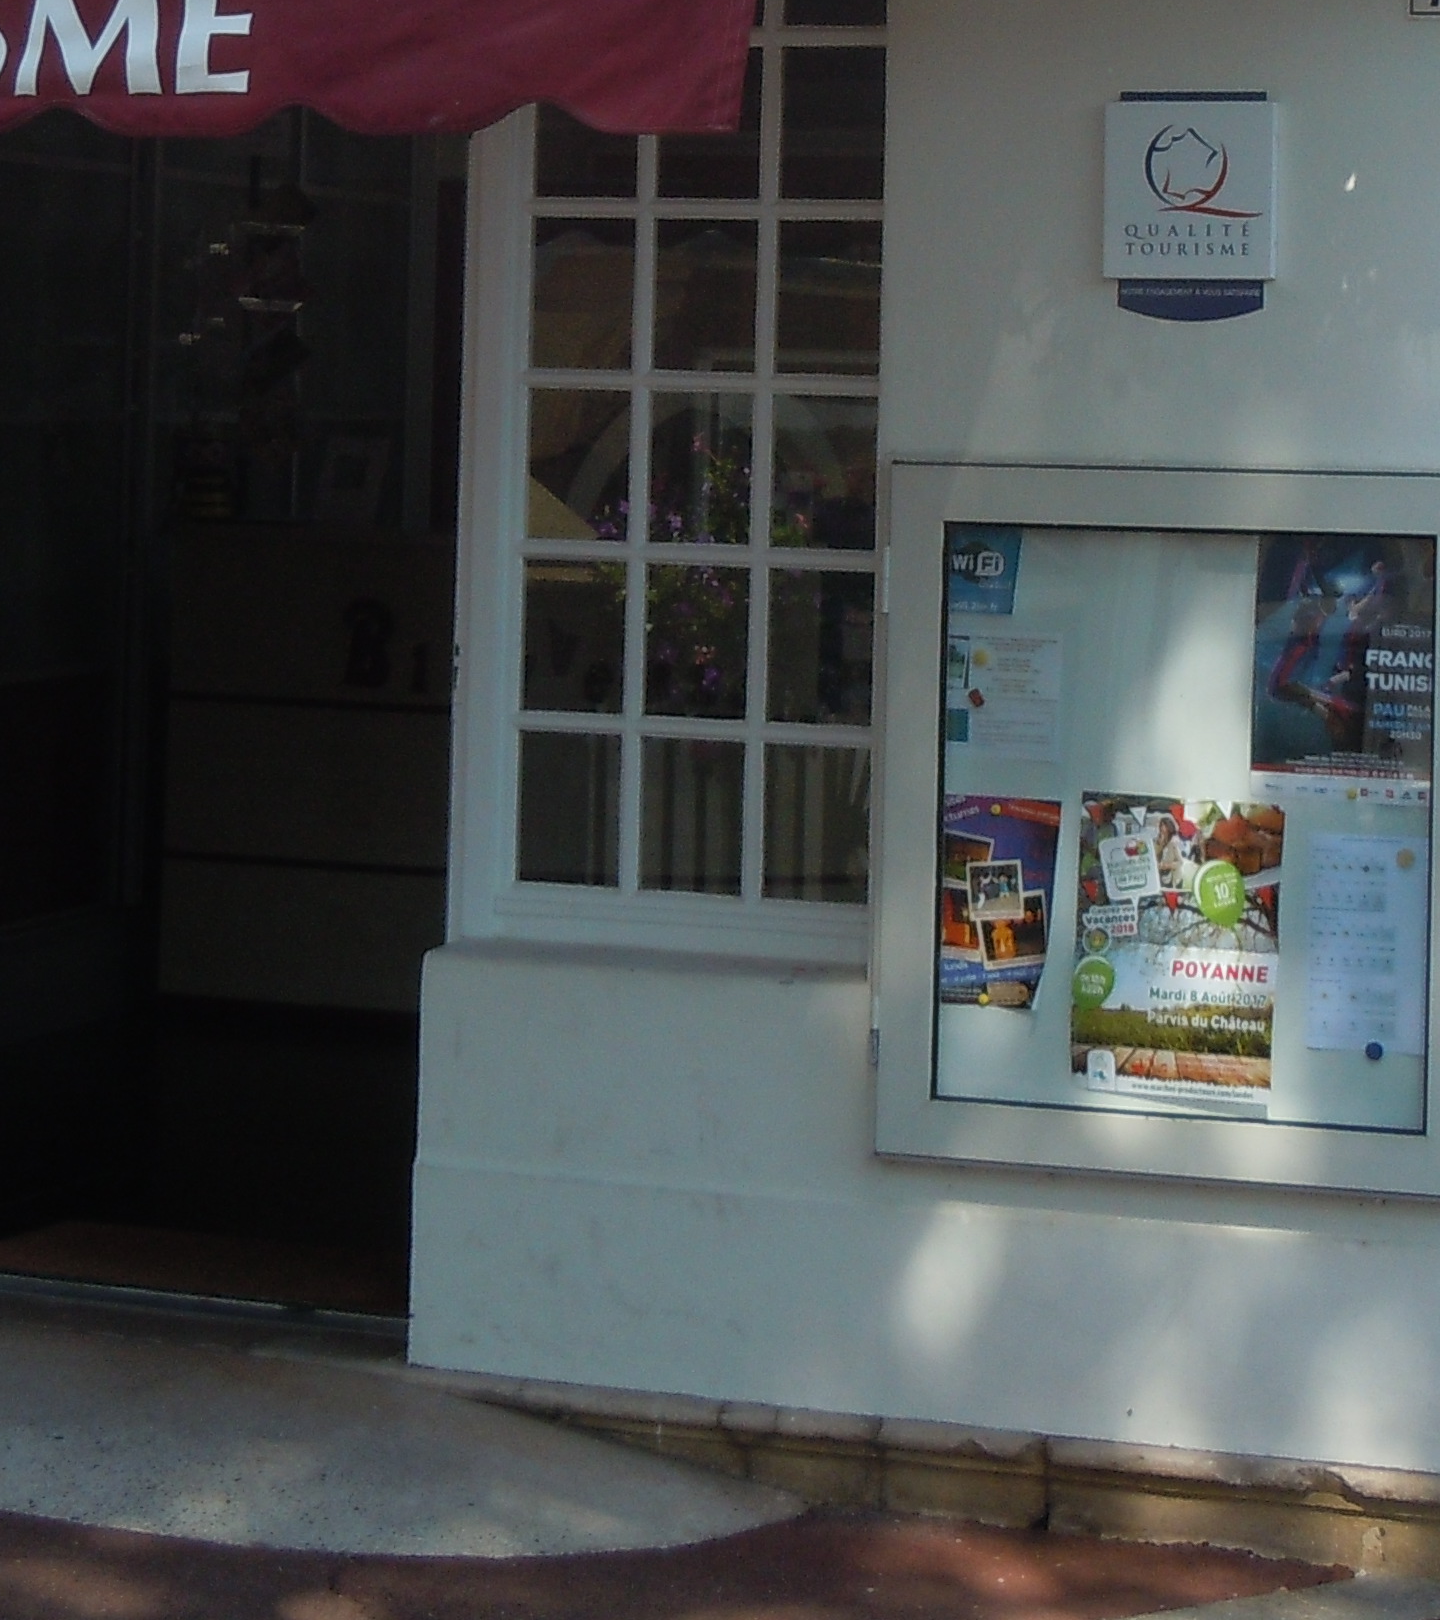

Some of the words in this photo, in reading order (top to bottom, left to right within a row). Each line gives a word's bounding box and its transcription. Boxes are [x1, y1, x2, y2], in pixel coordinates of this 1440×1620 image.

[1124, 221, 1249, 240] QUALITÉ
[1125, 242, 1249, 256] TOURISME
[1171, 960, 1269, 984] POYANNE
[1149, 986, 1186, 1001] Mardi
[1190, 990, 1198, 1001] 8
[1201, 990, 1232, 1005] Août
[1235, 991, 1267, 1006] 2017
[1147, 1009, 1188, 1026] Parvis
[1191, 1013, 1208, 1028] du
[1210, 1014, 1265, 1033] Château
